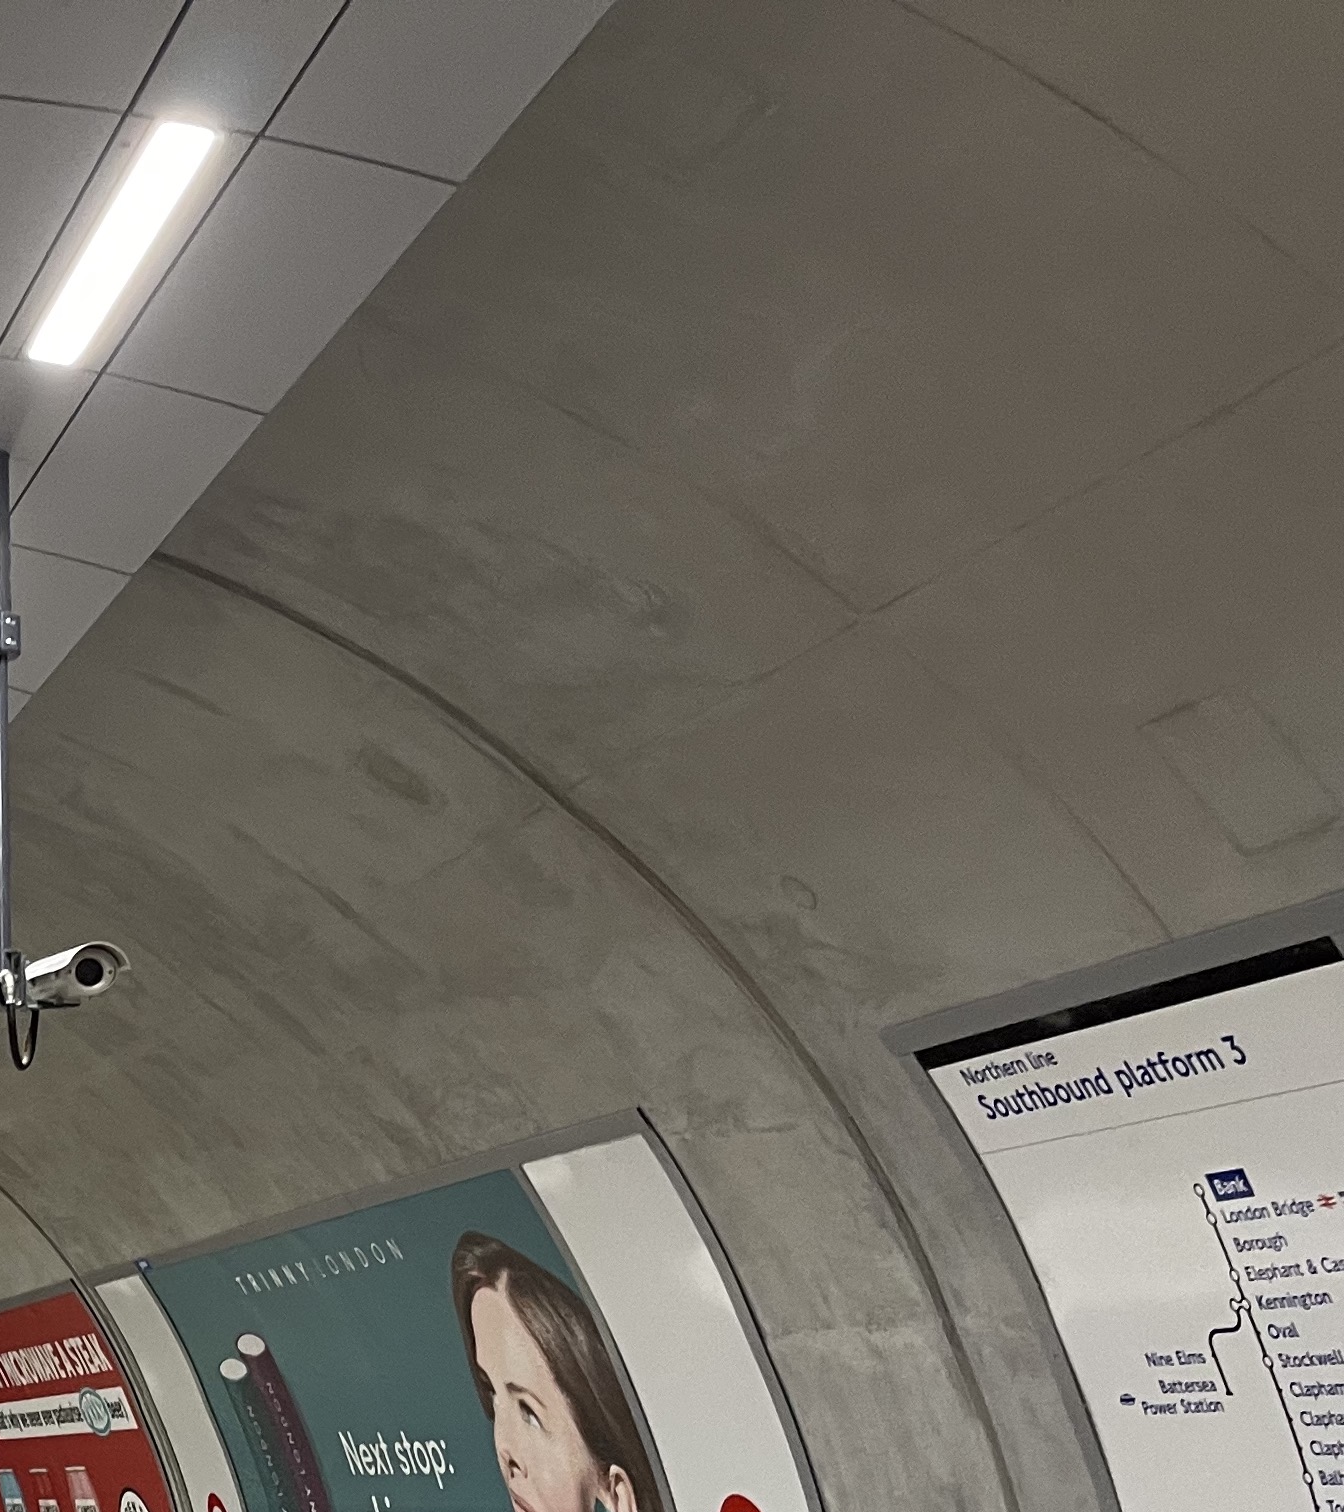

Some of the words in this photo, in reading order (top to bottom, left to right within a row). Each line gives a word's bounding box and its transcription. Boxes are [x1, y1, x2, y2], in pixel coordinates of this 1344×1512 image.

[959, 1060, 1029, 1087] Northern
[1024, 1049, 1059, 1070] line
[977, 1067, 1114, 1120] Southbound
[1113, 1048, 1226, 1098] platform
[1221, 1034, 1247, 1066] 3
[1213, 1175, 1250, 1195] Bank
[1220, 1205, 1271, 1224] London
[1271, 1196, 1316, 1218] Bridge
[1233, 1231, 1288, 1253] Borough
[235, 1261, 310, 1295] TRINNY
[311, 1238, 404, 1278] LONDON
[1244, 1262, 1305, 1284] Elephant
[1305, 1258, 1319, 1275] &
[1255, 1291, 1334, 1311] Kennington
[1267, 1322, 1300, 1340] Oval
[1144, 1352, 1175, 1368] Nine
[1175, 1350, 1207, 1366] Elms
[1277, 1348, 1344, 1369] Stockwell
[1159, 1379, 1217, 1395] Battersea
[1141, 1400, 1179, 1416] Power
[1179, 1398, 1225, 1415] Station
[338, 1430, 394, 1475] Next
[394, 1430, 455, 1490] stop:
